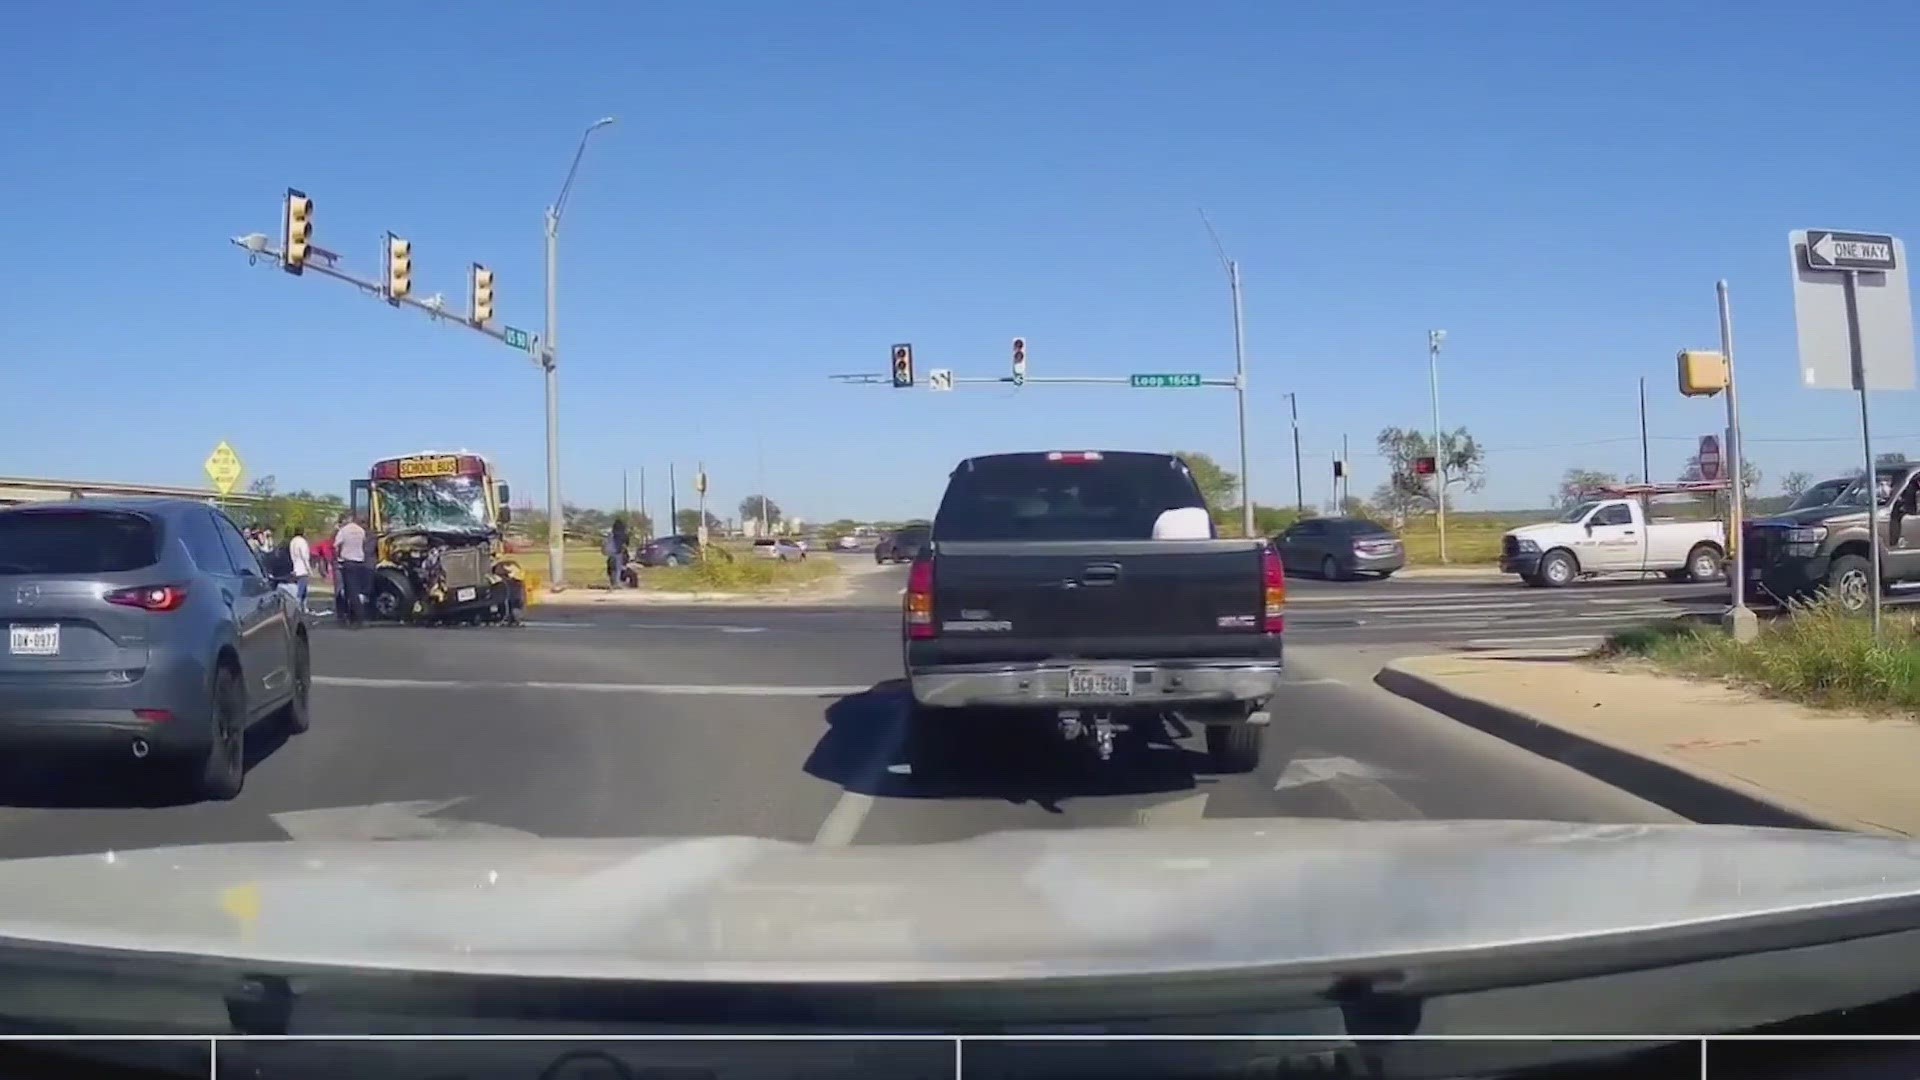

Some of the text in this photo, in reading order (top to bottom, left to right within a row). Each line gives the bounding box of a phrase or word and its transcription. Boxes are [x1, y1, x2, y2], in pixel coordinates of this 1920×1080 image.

[1834, 242, 1885, 259] ONE WAY
[1134, 375, 1197, 387] Loop 1604
[401, 460, 456, 475] SCHOOL BUS
